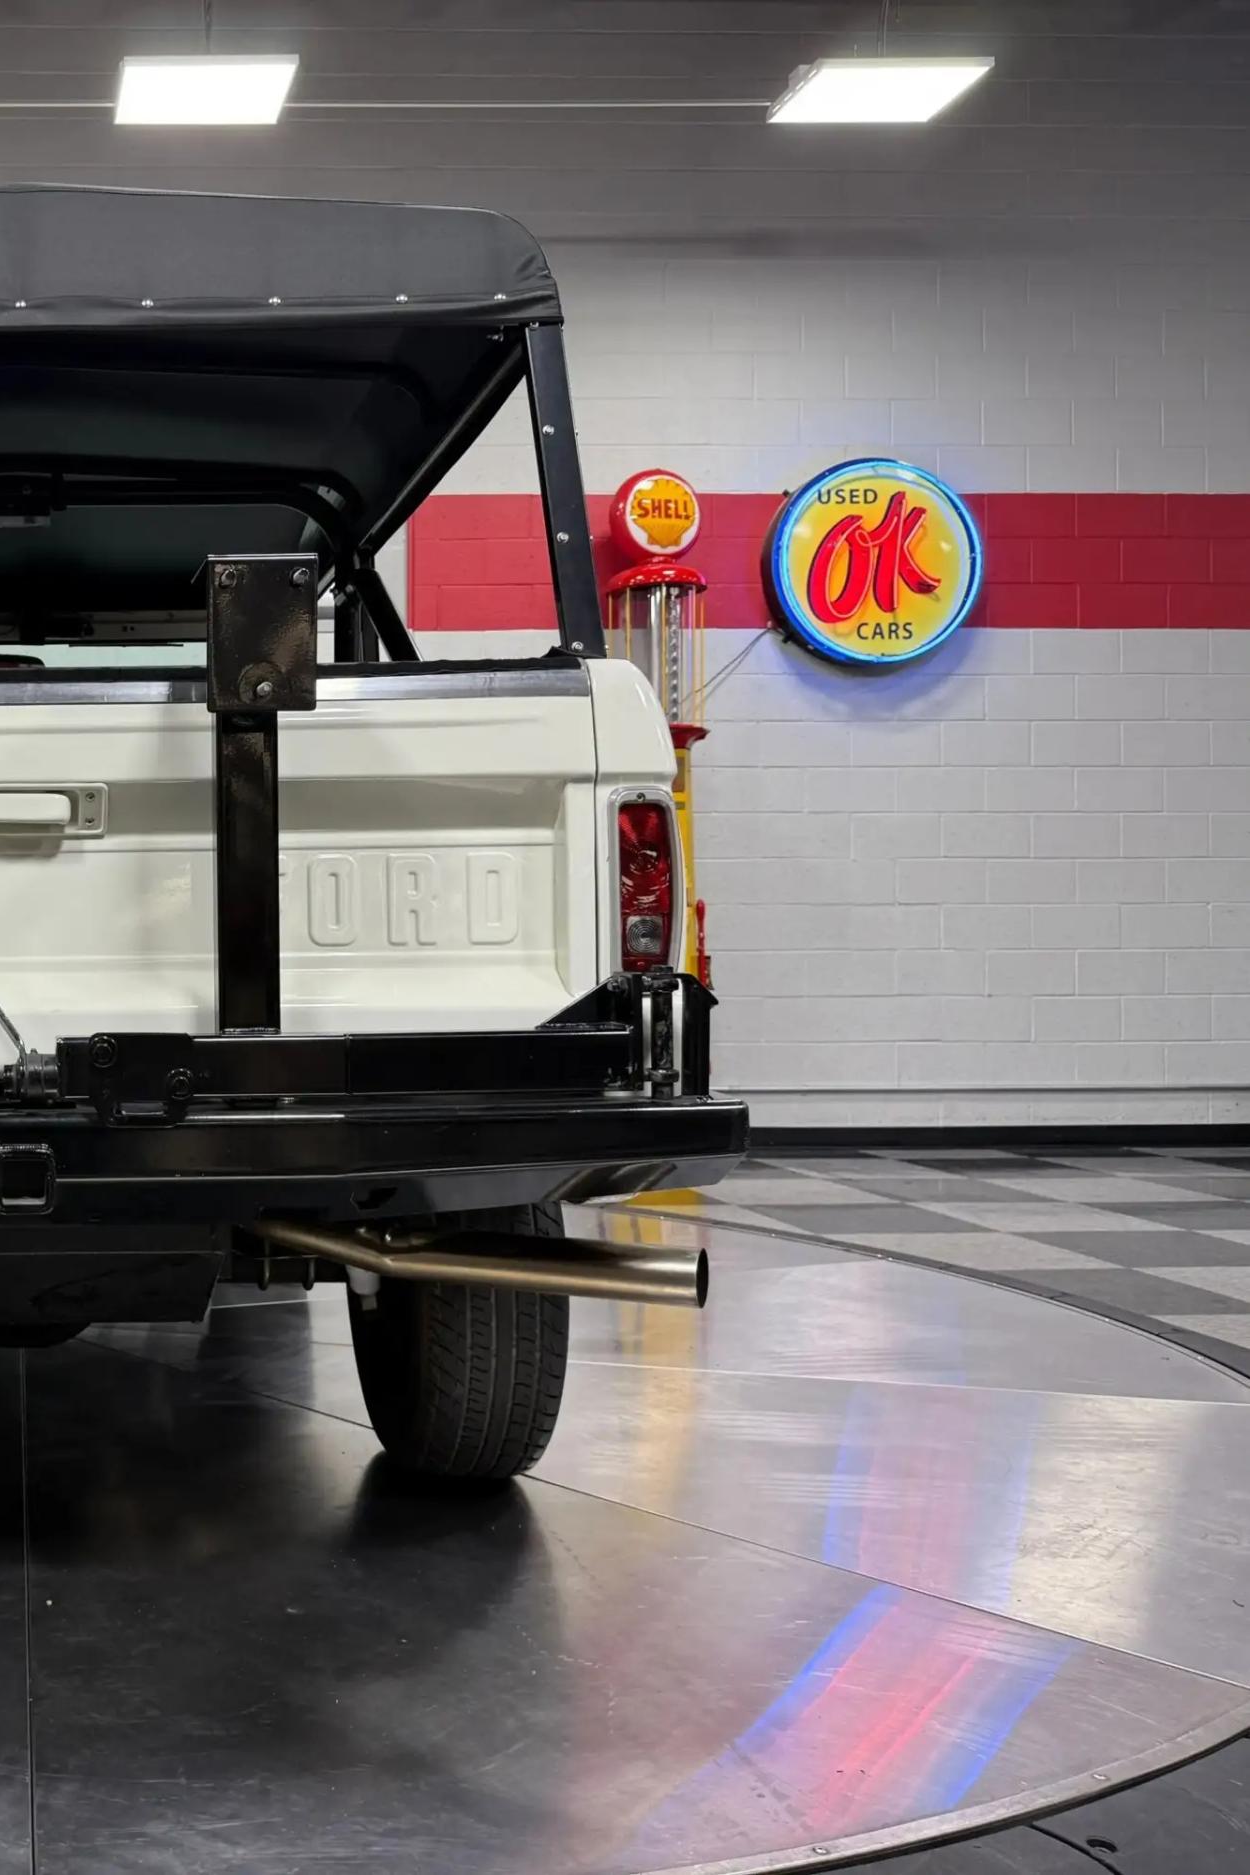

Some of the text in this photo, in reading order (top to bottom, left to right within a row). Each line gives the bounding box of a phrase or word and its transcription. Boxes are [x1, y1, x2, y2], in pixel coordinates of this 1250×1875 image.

[817, 488, 878, 505] USED
[637, 498, 692, 520] SHELL
[807, 491, 942, 624] OK
[856, 623, 914, 640] CARS
[279, 851, 521, 947] ORD
